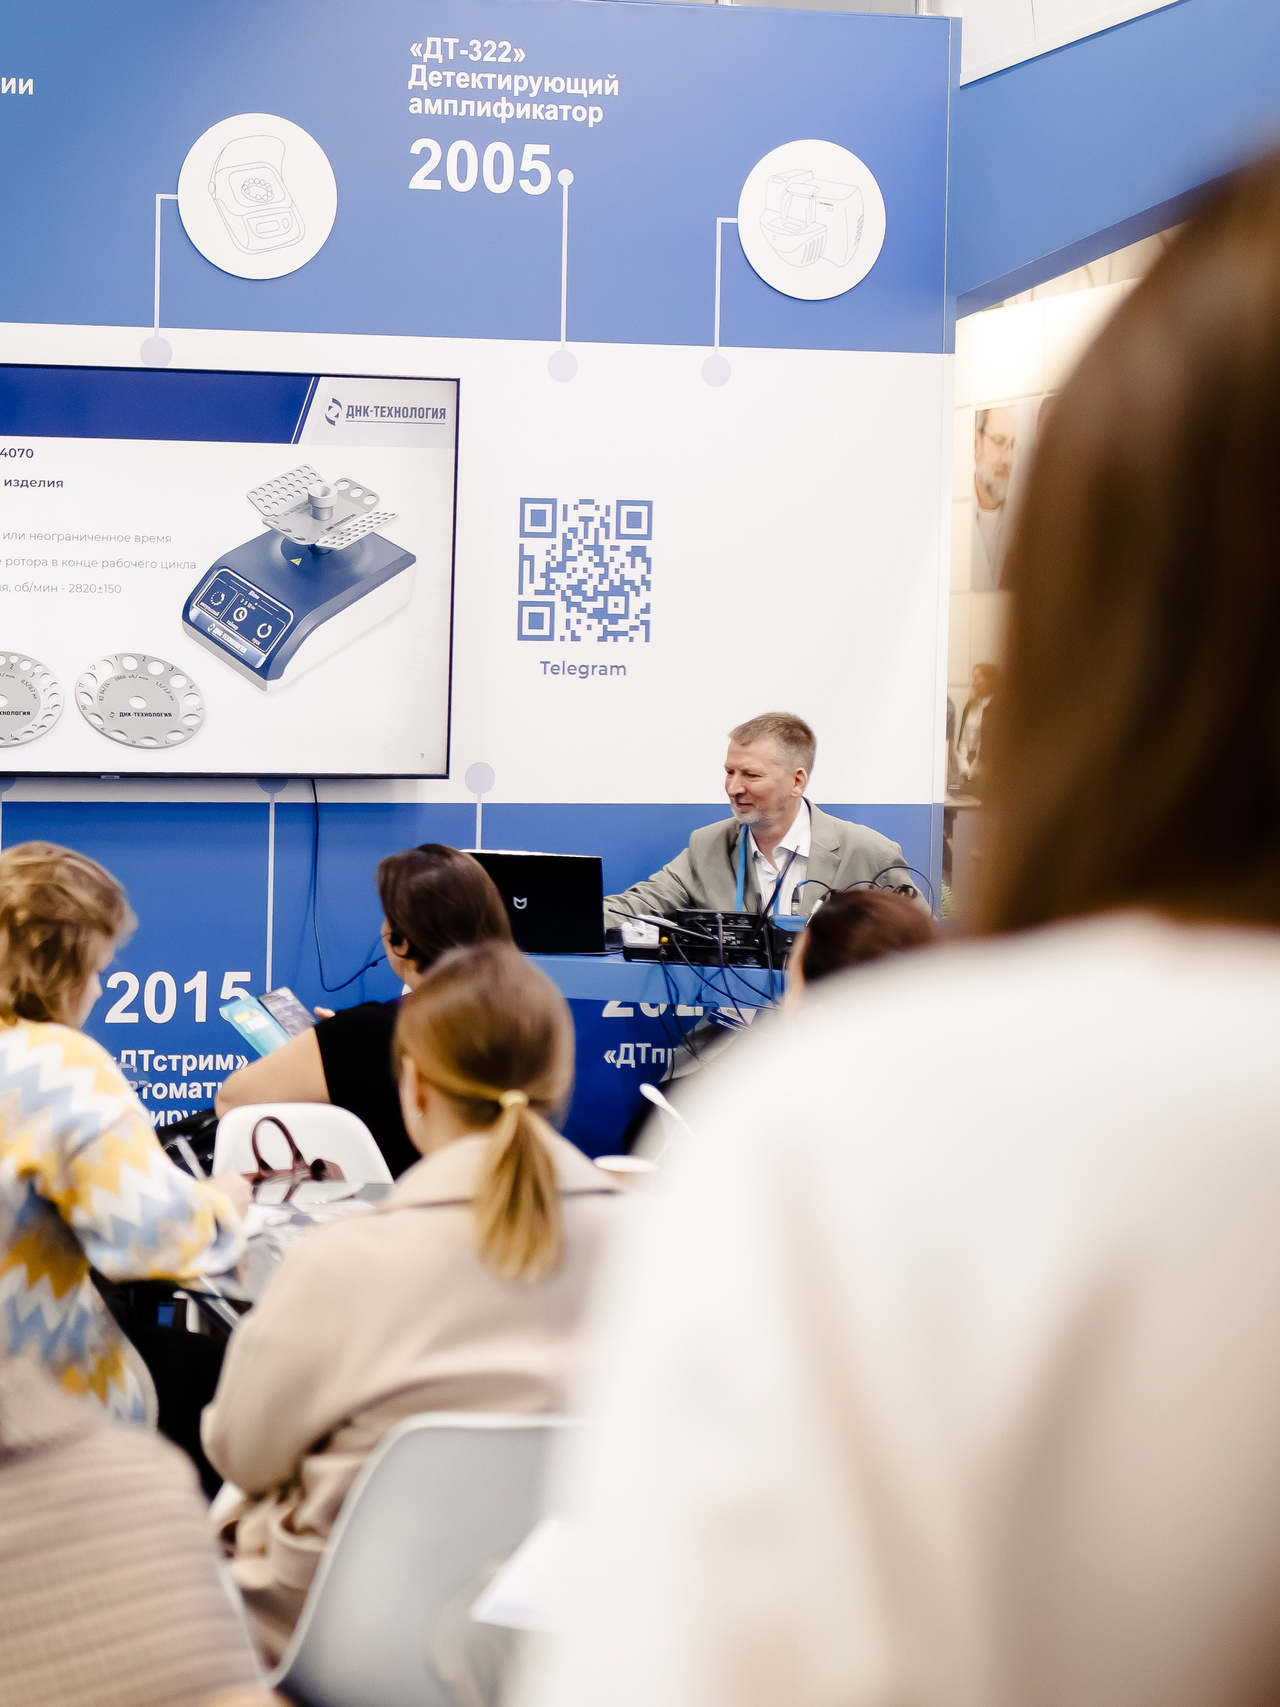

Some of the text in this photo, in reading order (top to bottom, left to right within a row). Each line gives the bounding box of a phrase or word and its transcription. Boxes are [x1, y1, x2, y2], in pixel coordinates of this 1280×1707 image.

[409, 37, 526, 63] «ДТ-322»
[408, 65, 620, 97] Детектирующий
[408, 95, 604, 127] амплификатор
[408, 138, 552, 195] 2005
[346, 405, 446, 419] ДНК-ТЕХНОЛОГИЯ
[4, 478, 64, 489] изделия
[3, 532, 26, 541] или
[29, 531, 131, 544] неограниченное
[134, 534, 172, 545] время
[5, 558, 48, 568] ротора
[51, 559, 59, 567] в
[61, 559, 98, 568] конце
[101, 558, 158, 570] рабочего
[161, 560, 197, 570] цикла
[14, 581, 58, 593] об/мин
[68, 583, 122, 594] 2820±150
[540, 661, 627, 679] Telegram
[104, 970, 252, 1024] 2015
[113, 1049, 249, 1077] ДТстрим»
